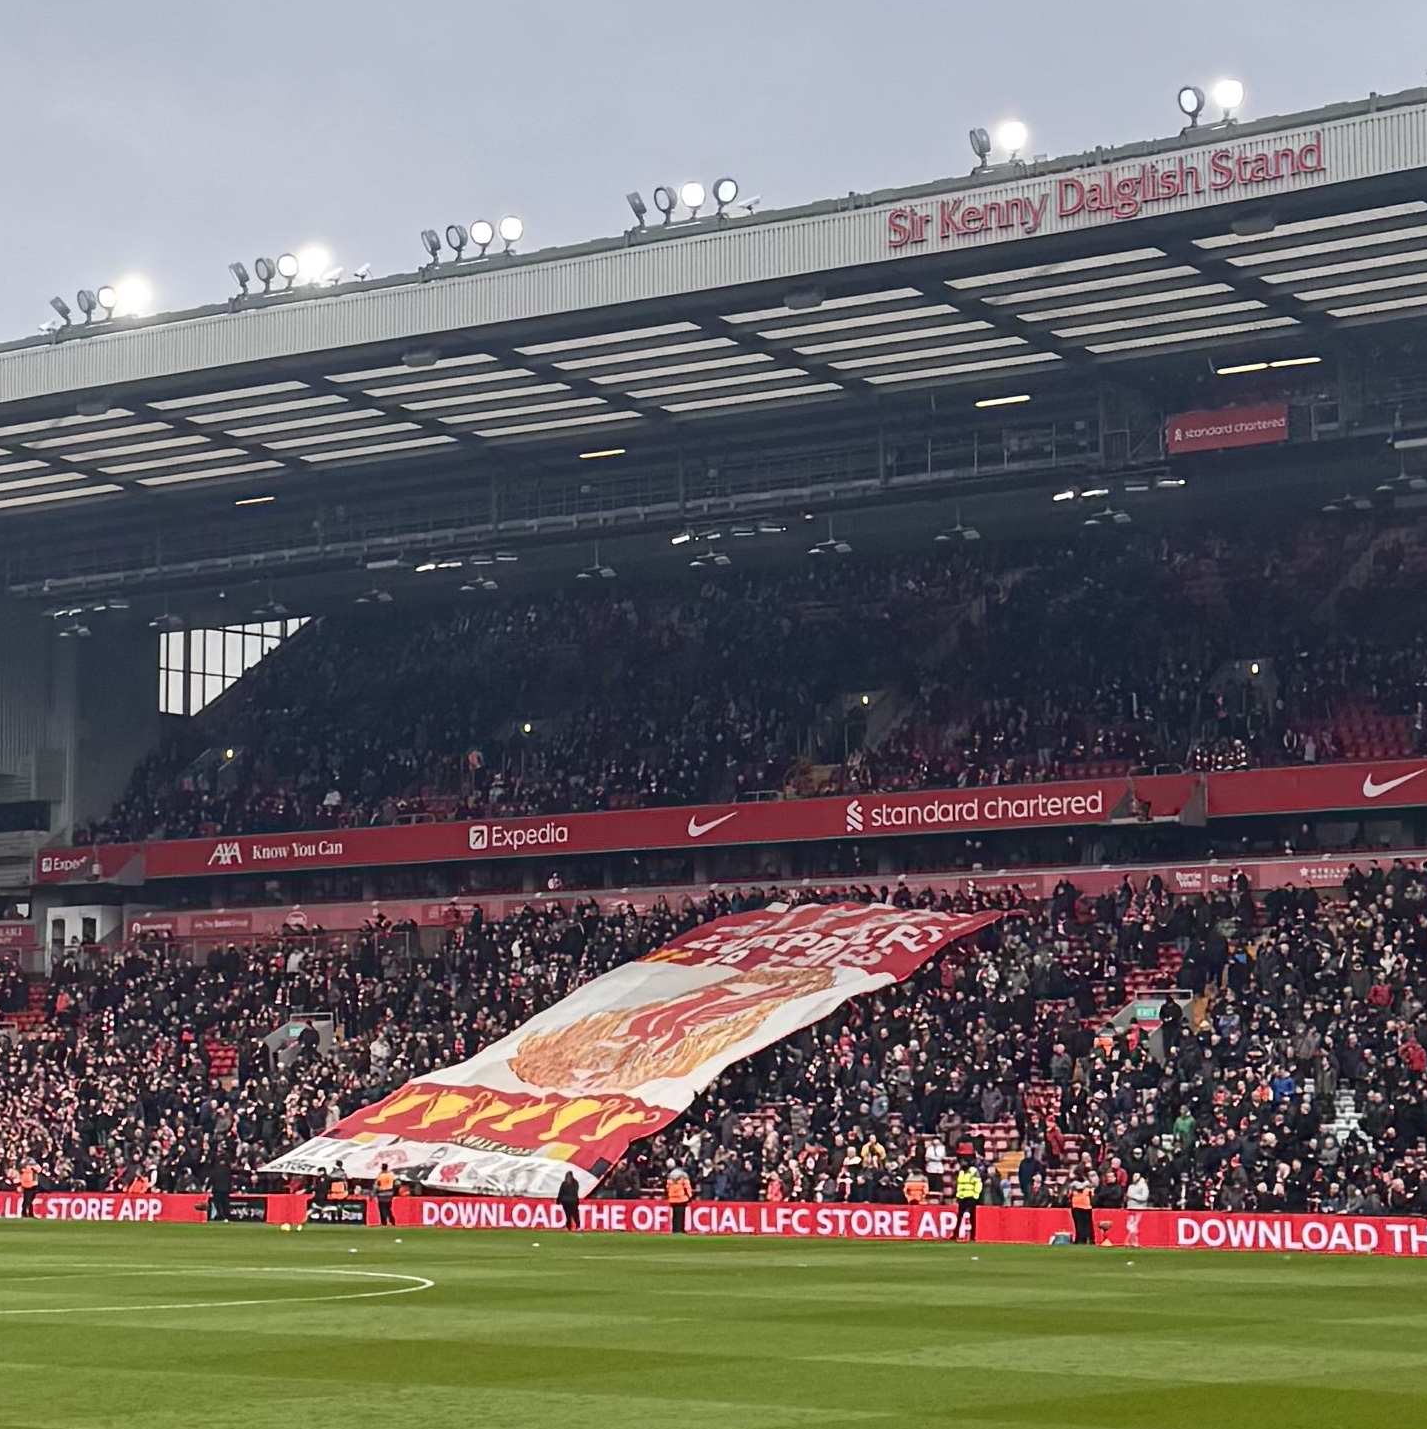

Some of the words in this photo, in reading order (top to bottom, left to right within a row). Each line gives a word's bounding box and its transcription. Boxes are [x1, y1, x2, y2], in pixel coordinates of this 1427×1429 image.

[888, 204, 931, 249] Sir
[940, 191, 1050, 236] Kenny
[1057, 155, 1203, 219] Dalglish
[1210, 131, 1325, 191] Stand
[1185, 424, 1233, 439] standard
[1233, 417, 1286, 433] chartered
[871, 798, 979, 827] standard
[983, 790, 1103, 820] chartered
[492, 822, 568, 851] Expedia
[207, 842, 243, 866] AXA
[252, 845, 288, 860] Know
[291, 842, 316, 858] You
[318, 840, 343, 855] Can
[45, 1197, 115, 1221] STORE
[117, 1198, 162, 1222] APP
[422, 1201, 567, 1229] DOWNLOAD
[577, 1204, 627, 1231] THE
[632, 1205, 755, 1234] OFICIAL
[760, 1207, 811, 1235] LFC
[816, 1208, 911, 1237] STORE
[1177, 1217, 1379, 1253] DOWNLOAD
